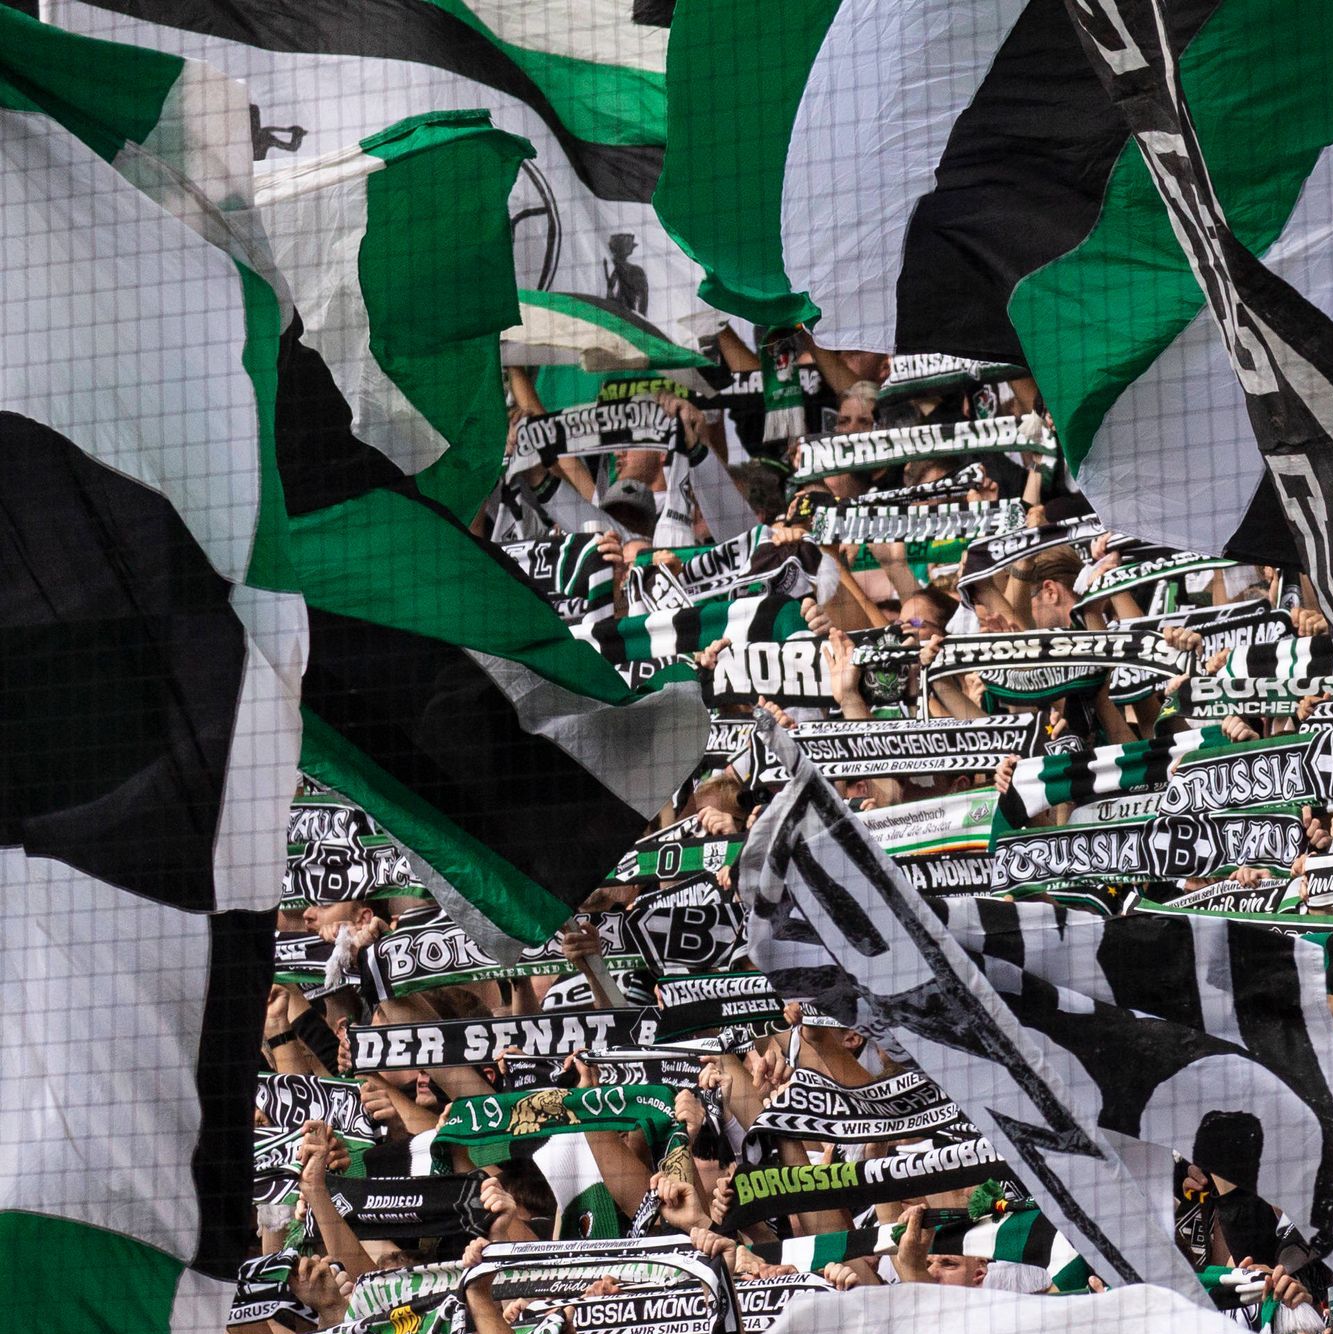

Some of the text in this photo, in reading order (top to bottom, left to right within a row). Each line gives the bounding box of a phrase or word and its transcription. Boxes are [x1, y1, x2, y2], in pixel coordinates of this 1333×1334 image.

[932, 631, 1176, 668] ITION SEIT 19
[1192, 699, 1302, 717] MÖNCHEN
[852, 730, 1027, 758] MÖNCHENGLADBACH
[841, 758, 946, 774] WIR SIND BORUSSIA
[930, 855, 998, 889] MÖNCH
[354, 1029, 446, 1069] DER
[463, 1015, 616, 1062] SENAT
[887, 1071, 926, 1095] NIE
[466, 1087, 628, 1131] 19 00
[842, 1120, 870, 1136] WIR
[872, 1116, 905, 1132] SIND
[735, 1161, 859, 1204] BORUSSIA
[227, 1302, 281, 1322] BORUSS
